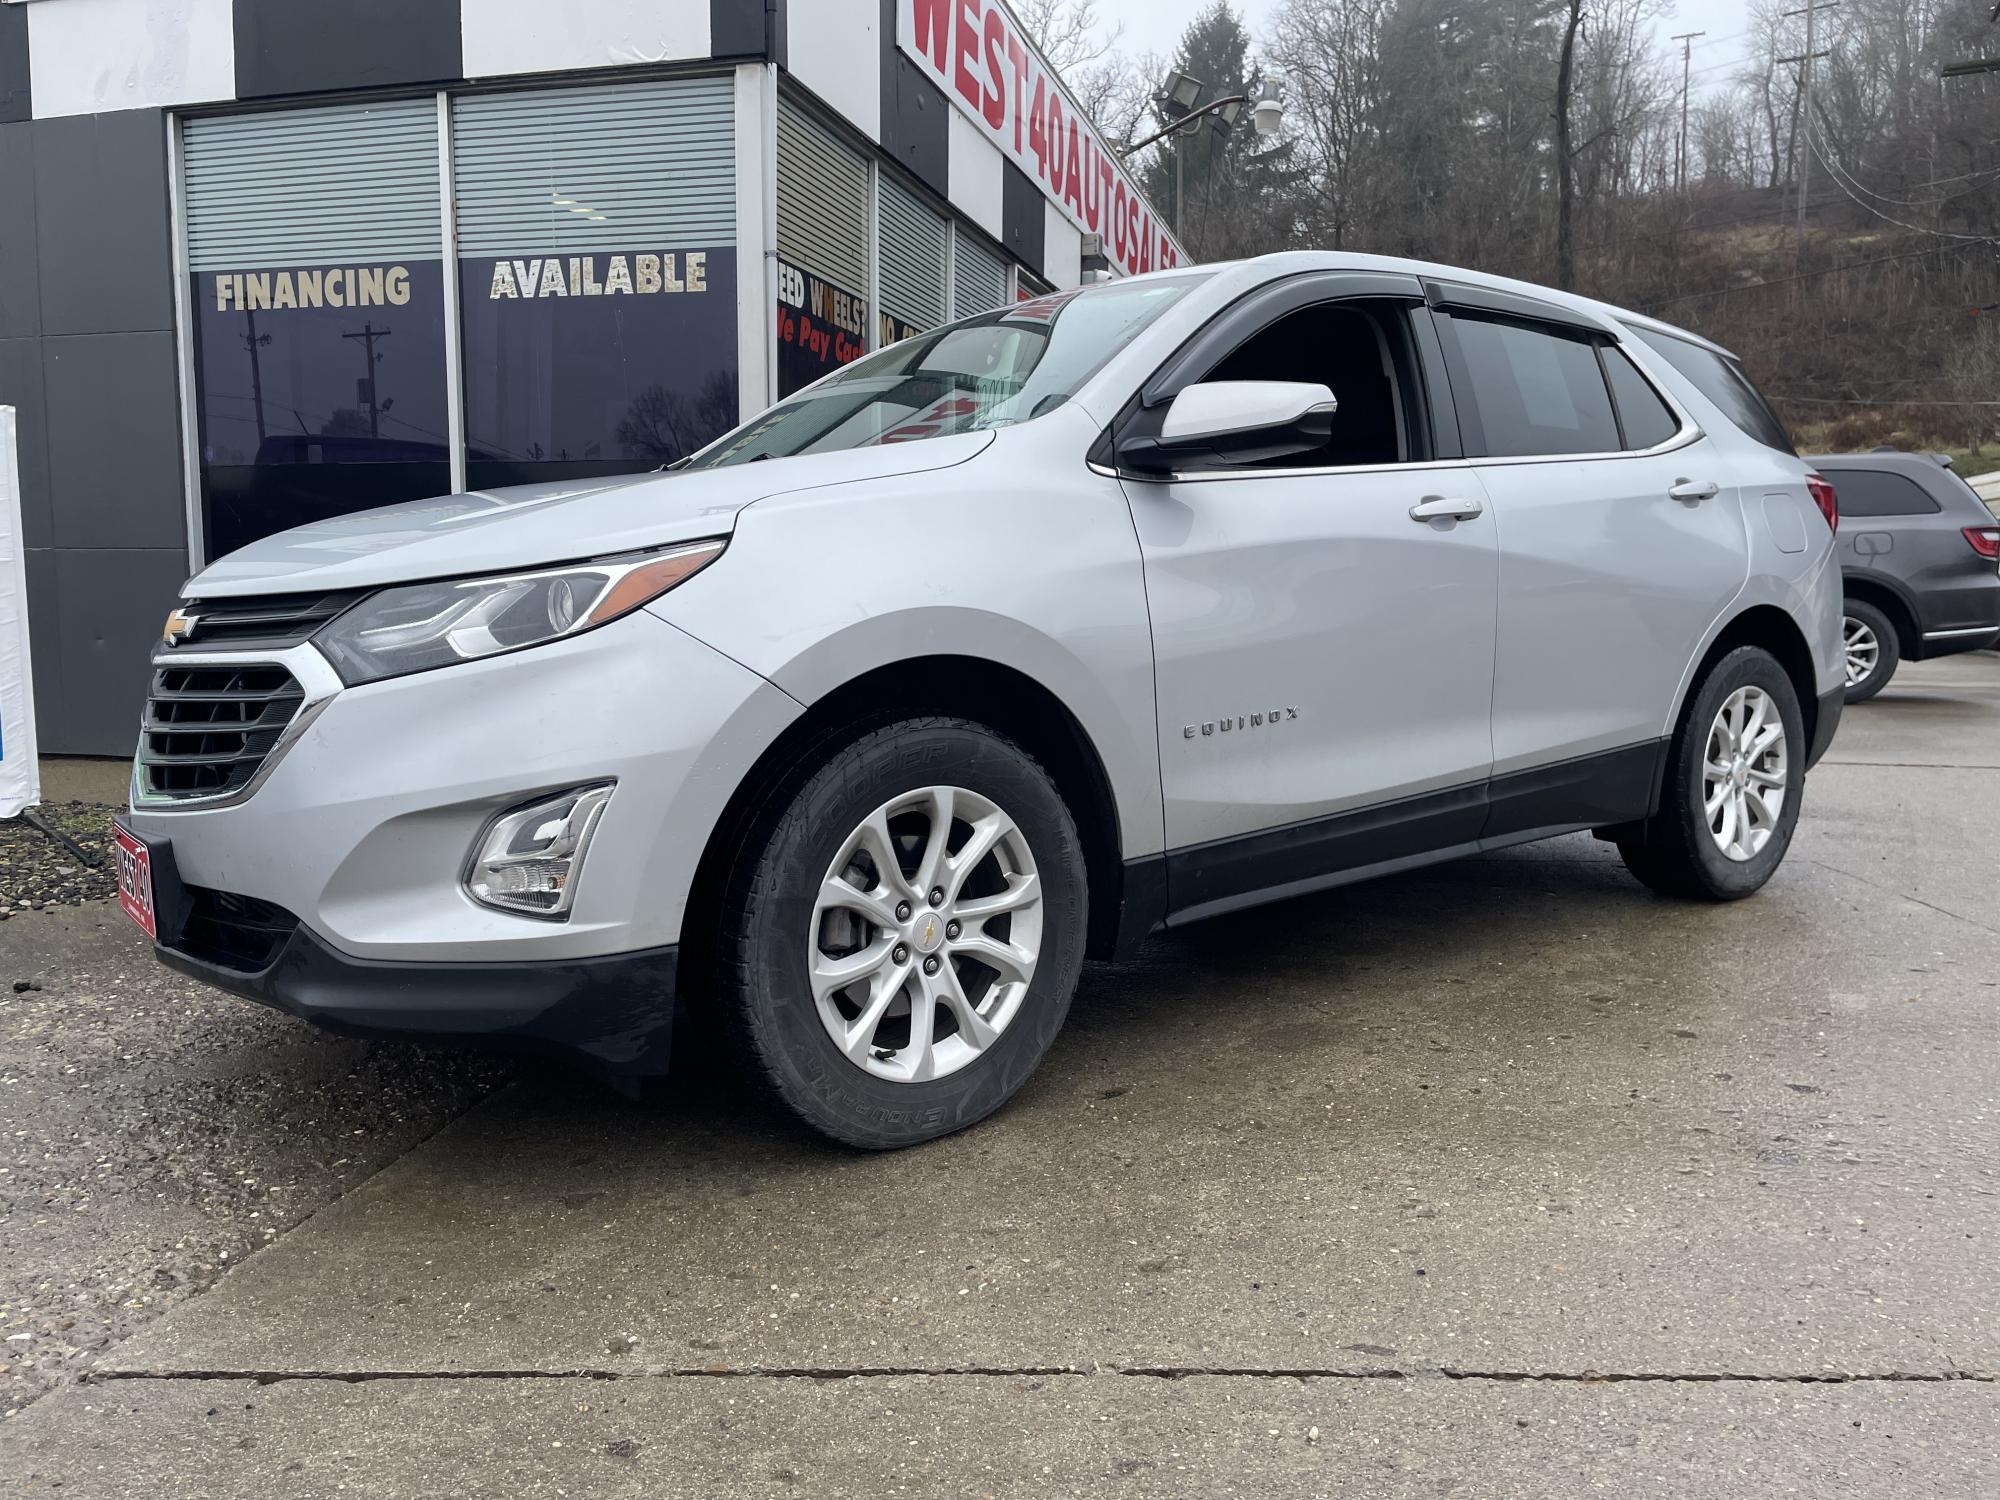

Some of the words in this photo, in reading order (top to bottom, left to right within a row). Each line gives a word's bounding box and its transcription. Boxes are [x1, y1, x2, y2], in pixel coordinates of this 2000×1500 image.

[215, 265, 411, 312] FINANCING
[489, 252, 707, 299] AVAILABLE
[778, 261, 804, 308] EED
[810, 277, 867, 337] WHEELS?
[799, 316, 830, 362] Pay
[879, 313, 895, 346] NO
[1183, 705, 1298, 739] EQUINOX
[808, 743, 949, 849] COOPER
